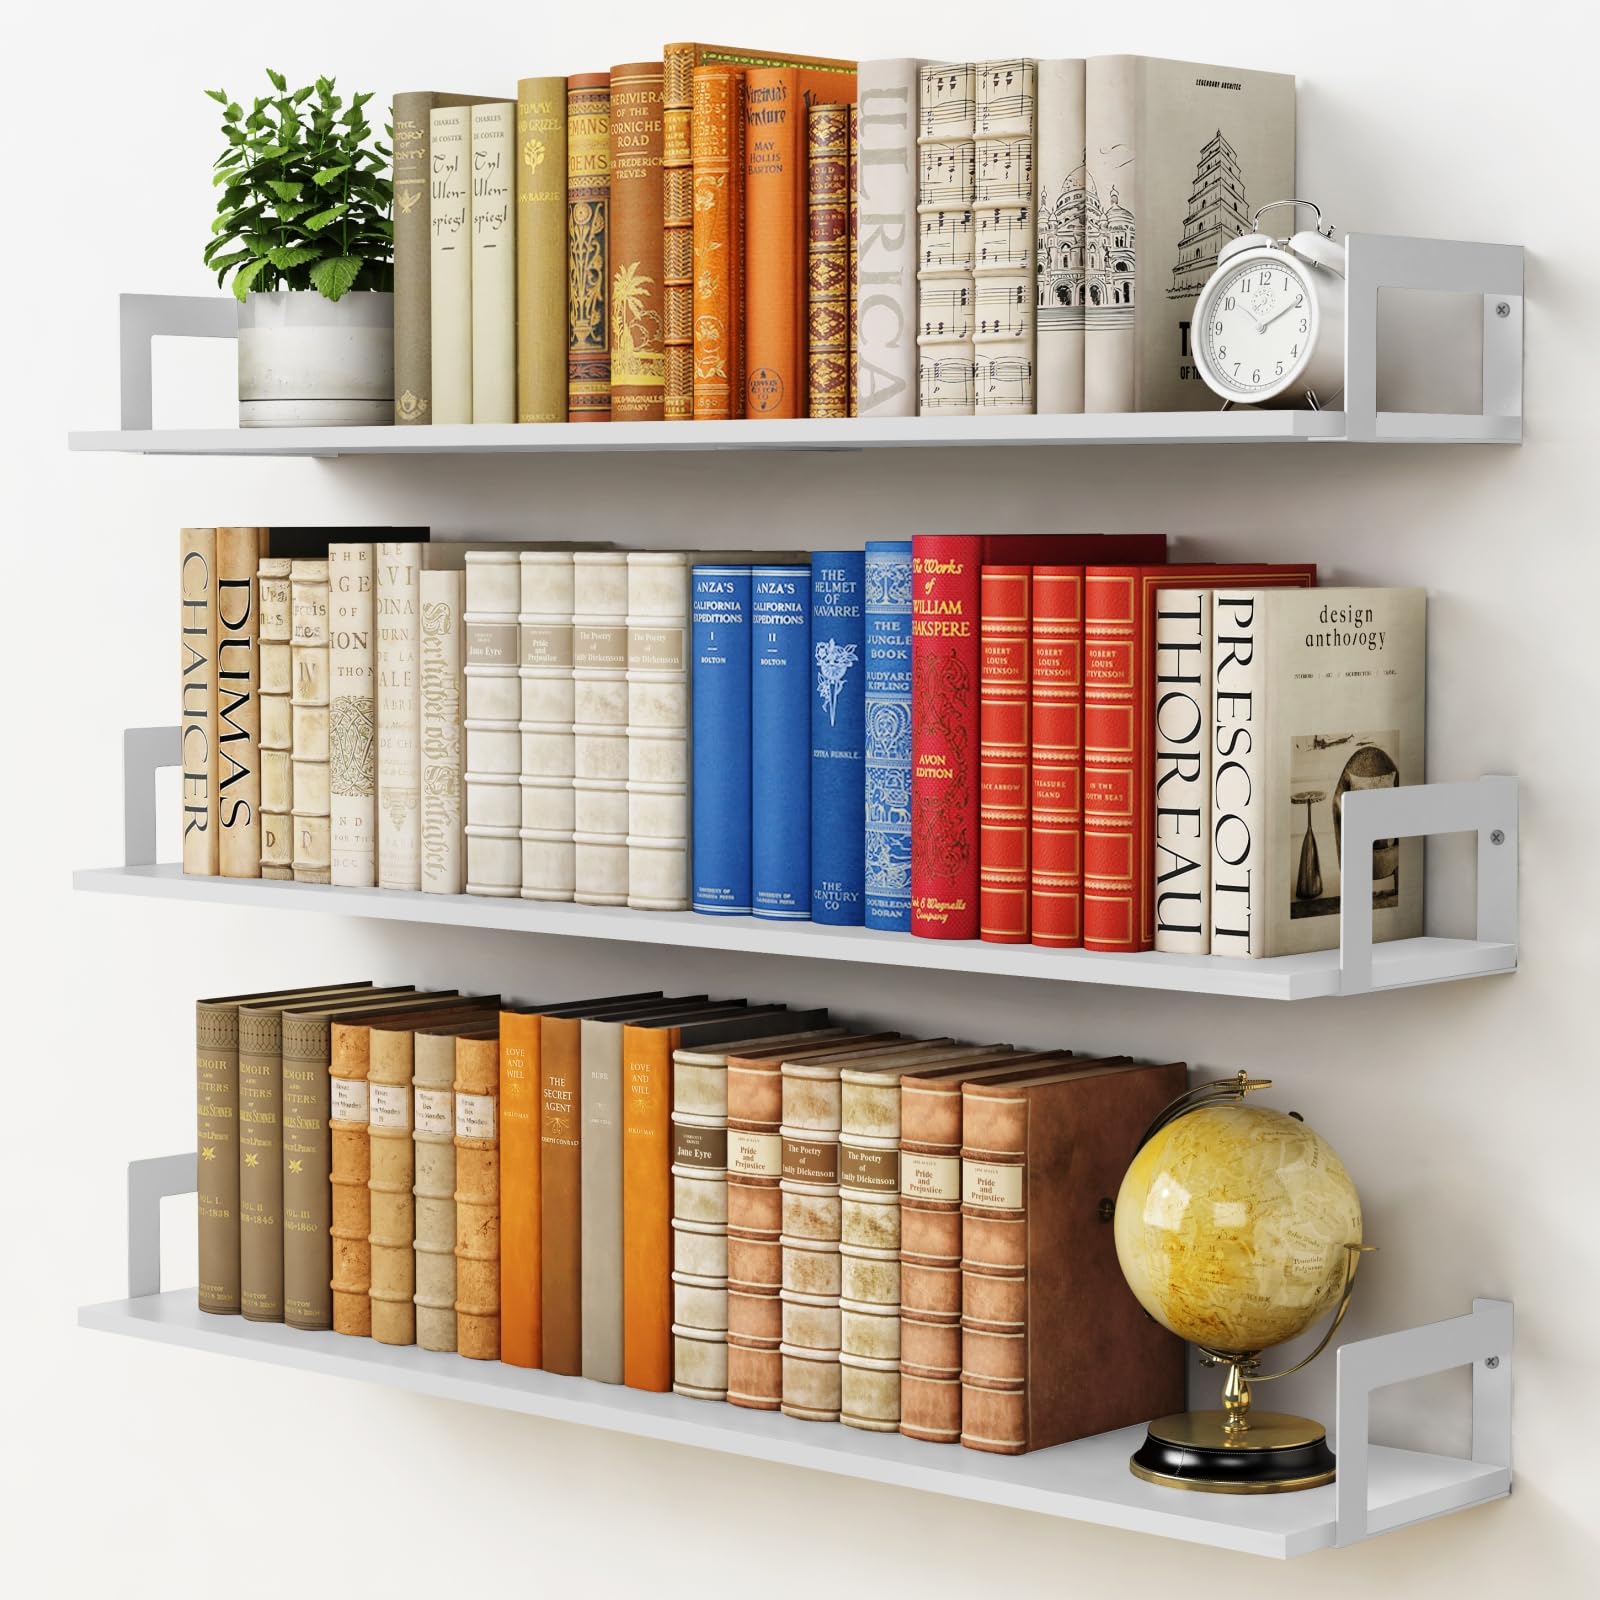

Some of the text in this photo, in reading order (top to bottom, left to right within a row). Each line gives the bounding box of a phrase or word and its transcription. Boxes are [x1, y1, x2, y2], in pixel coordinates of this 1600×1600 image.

[1196, 79, 1220, 88] LEGENDARY
[630, 108, 648, 116] THE
[611, 121, 662, 135] CORNICHE
[618, 136, 650, 148] ROAD
[754, 142, 774, 151] MAY
[750, 154, 781, 164] HOLLIS
[616, 170, 647, 180] TREVES
[859, 86, 908, 414] ULRICA
[1259, 271, 1272, 286] 12
[1241, 278, 1250, 292] 11
[1284, 277, 1288, 292] 1
[1224, 296, 1236, 311] 10
[1294, 294, 1304, 308] 2
[1216, 322, 1222, 336] 9
[1298, 318, 1307, 334] 3
[1218, 346, 1226, 360] 8
[1290, 344, 1298, 358] 4
[1180, 366, 1190, 380] OF
[1234, 362, 1241, 376] 7
[1275, 362, 1283, 375] 5
[1252, 368, 1260, 384] 6
[330, 552, 367, 562] THE
[924, 558, 964, 574] Works
[821, 569, 846, 582] THE
[696, 582, 734, 592] ANZA'S
[756, 583, 795, 594] ANZA'S
[815, 582, 857, 594] HELMET
[924, 577, 936, 595] of
[694, 600, 742, 610] CALIFORNIA
[824, 594, 840, 605] OF
[339, 608, 358, 616] OF
[753, 602, 802, 612] CALIFORNIA
[814, 606, 860, 617] NAVARRE
[912, 600, 962, 615] WILLIAM
[694, 614, 742, 624] EXPEDITIONS
[752, 614, 804, 624] EXPEDITIONS
[1320, 604, 1373, 628] design
[874, 621, 900, 631] THE
[710, 632, 714, 640] I
[768, 632, 776, 642] II
[867, 635, 912, 645] JUNGLE
[871, 650, 908, 659] BOOK
[986, 657, 1008, 665] LOUIS
[1038, 658, 1060, 667] LOUIS
[1092, 660, 1114, 668] LOUIS
[866, 672, 912, 681] RUDYARD
[868, 680, 910, 691] KIPLING
[183, 552, 208, 844] CHAUCER
[218, 576, 251, 828] DUMAS
[919, 755, 946, 766] AVON
[1156, 594, 1202, 936] THOREAU
[916, 768, 953, 779] EDITION
[1214, 596, 1255, 955] PRESCOTT
[1036, 790, 1061, 799] ISLAND
[822, 881, 842, 891] THE
[814, 890, 860, 902] CENTURY
[824, 900, 840, 910] CO
[872, 908, 904, 918] DORAN
[506, 1048, 526, 1057] LOVE
[507, 1060, 524, 1068] AND
[630, 1062, 651, 1072] LOVE
[506, 1070, 524, 1079] WILL
[632, 1074, 650, 1084] AND
[550, 1076, 566, 1087] THE
[544, 1088, 573, 1101] SECRET
[631, 1086, 649, 1095] WILL
[544, 1102, 572, 1113] AGENT
[678, 1146, 712, 1160] Jane Eyre
[740, 1146, 758, 1155] Pride
[788, 1144, 822, 1157] The Poetry
[799, 1157, 806, 1165] of
[848, 1151, 882, 1164] The Poetry
[858, 1164, 867, 1172] of
[915, 1169, 934, 1178] Pride
[977, 1177, 996, 1187] Pride
[980, 1186, 993, 1194] and
